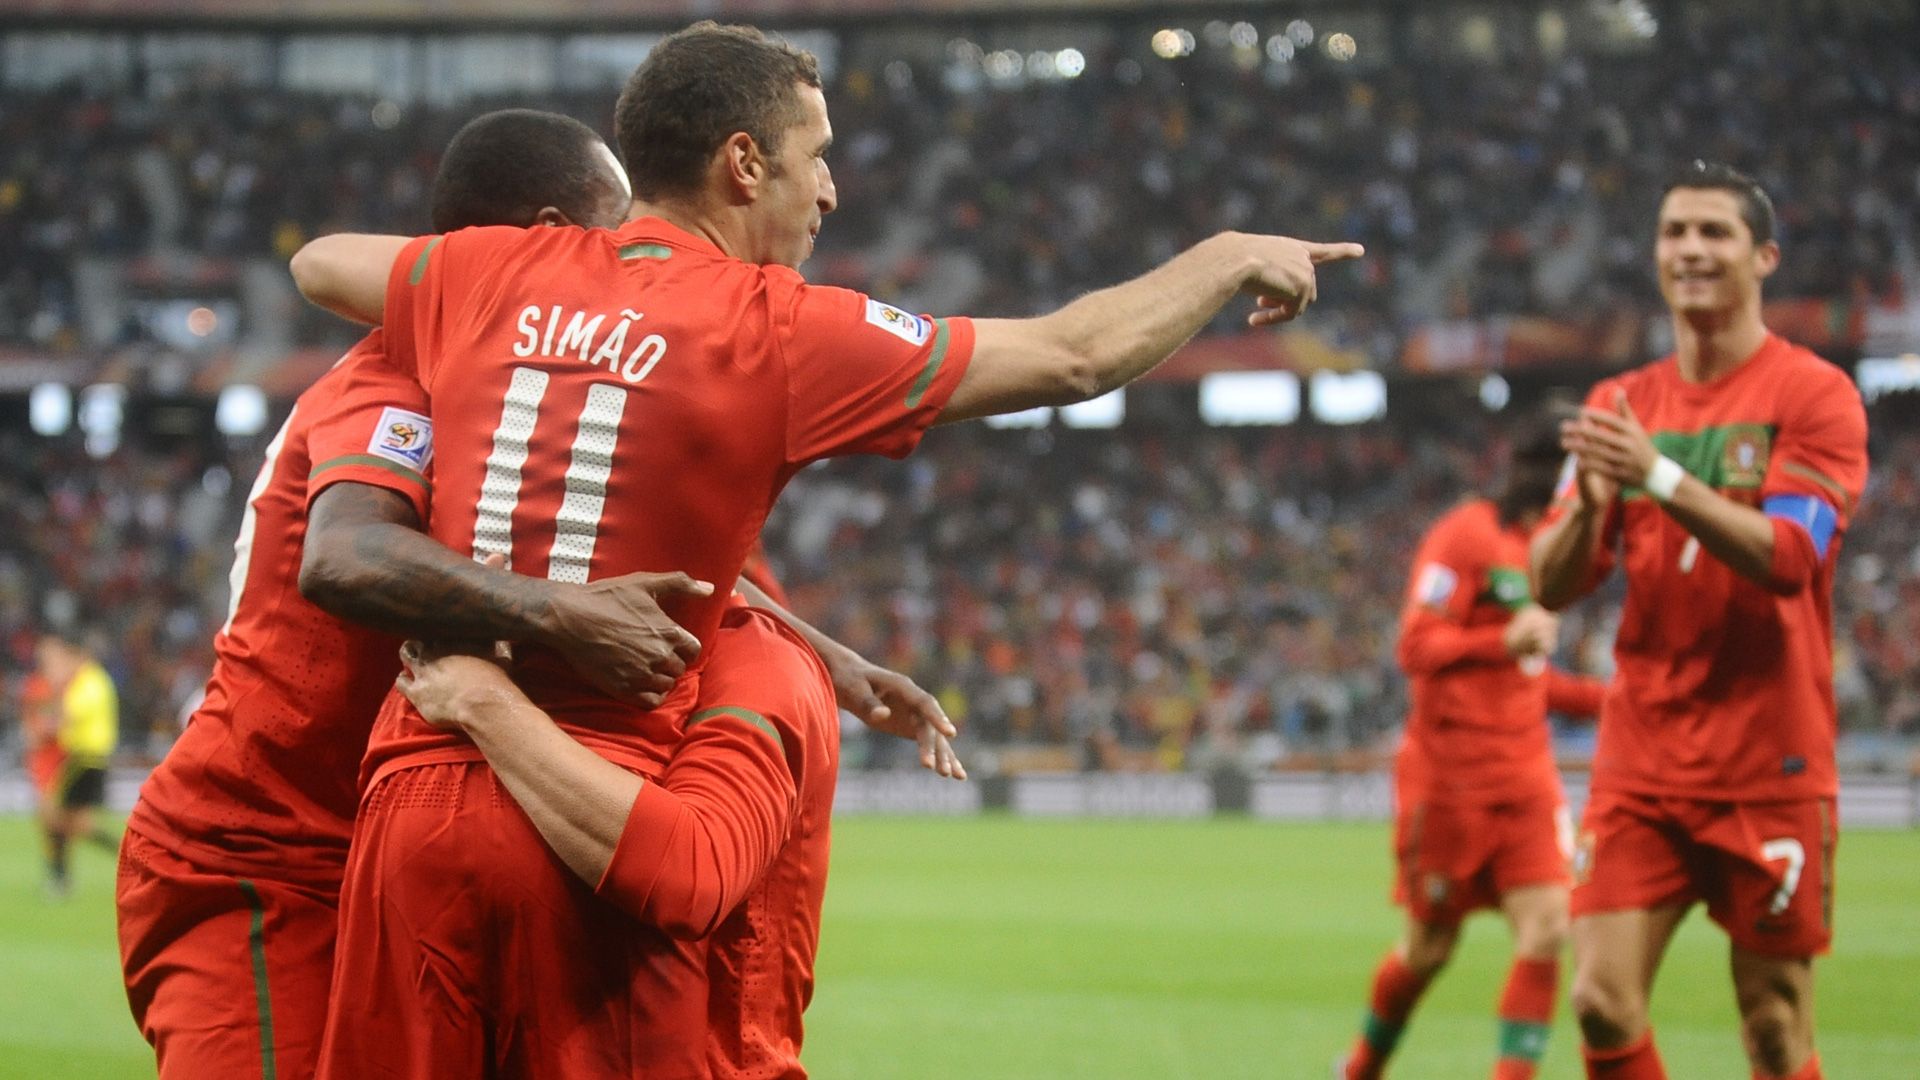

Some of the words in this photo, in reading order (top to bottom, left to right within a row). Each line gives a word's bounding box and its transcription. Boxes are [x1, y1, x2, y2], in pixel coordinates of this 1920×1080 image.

[513, 305, 667, 383] SIMÃO
[472, 367, 627, 585] 11
[1761, 837, 1805, 915] 7
